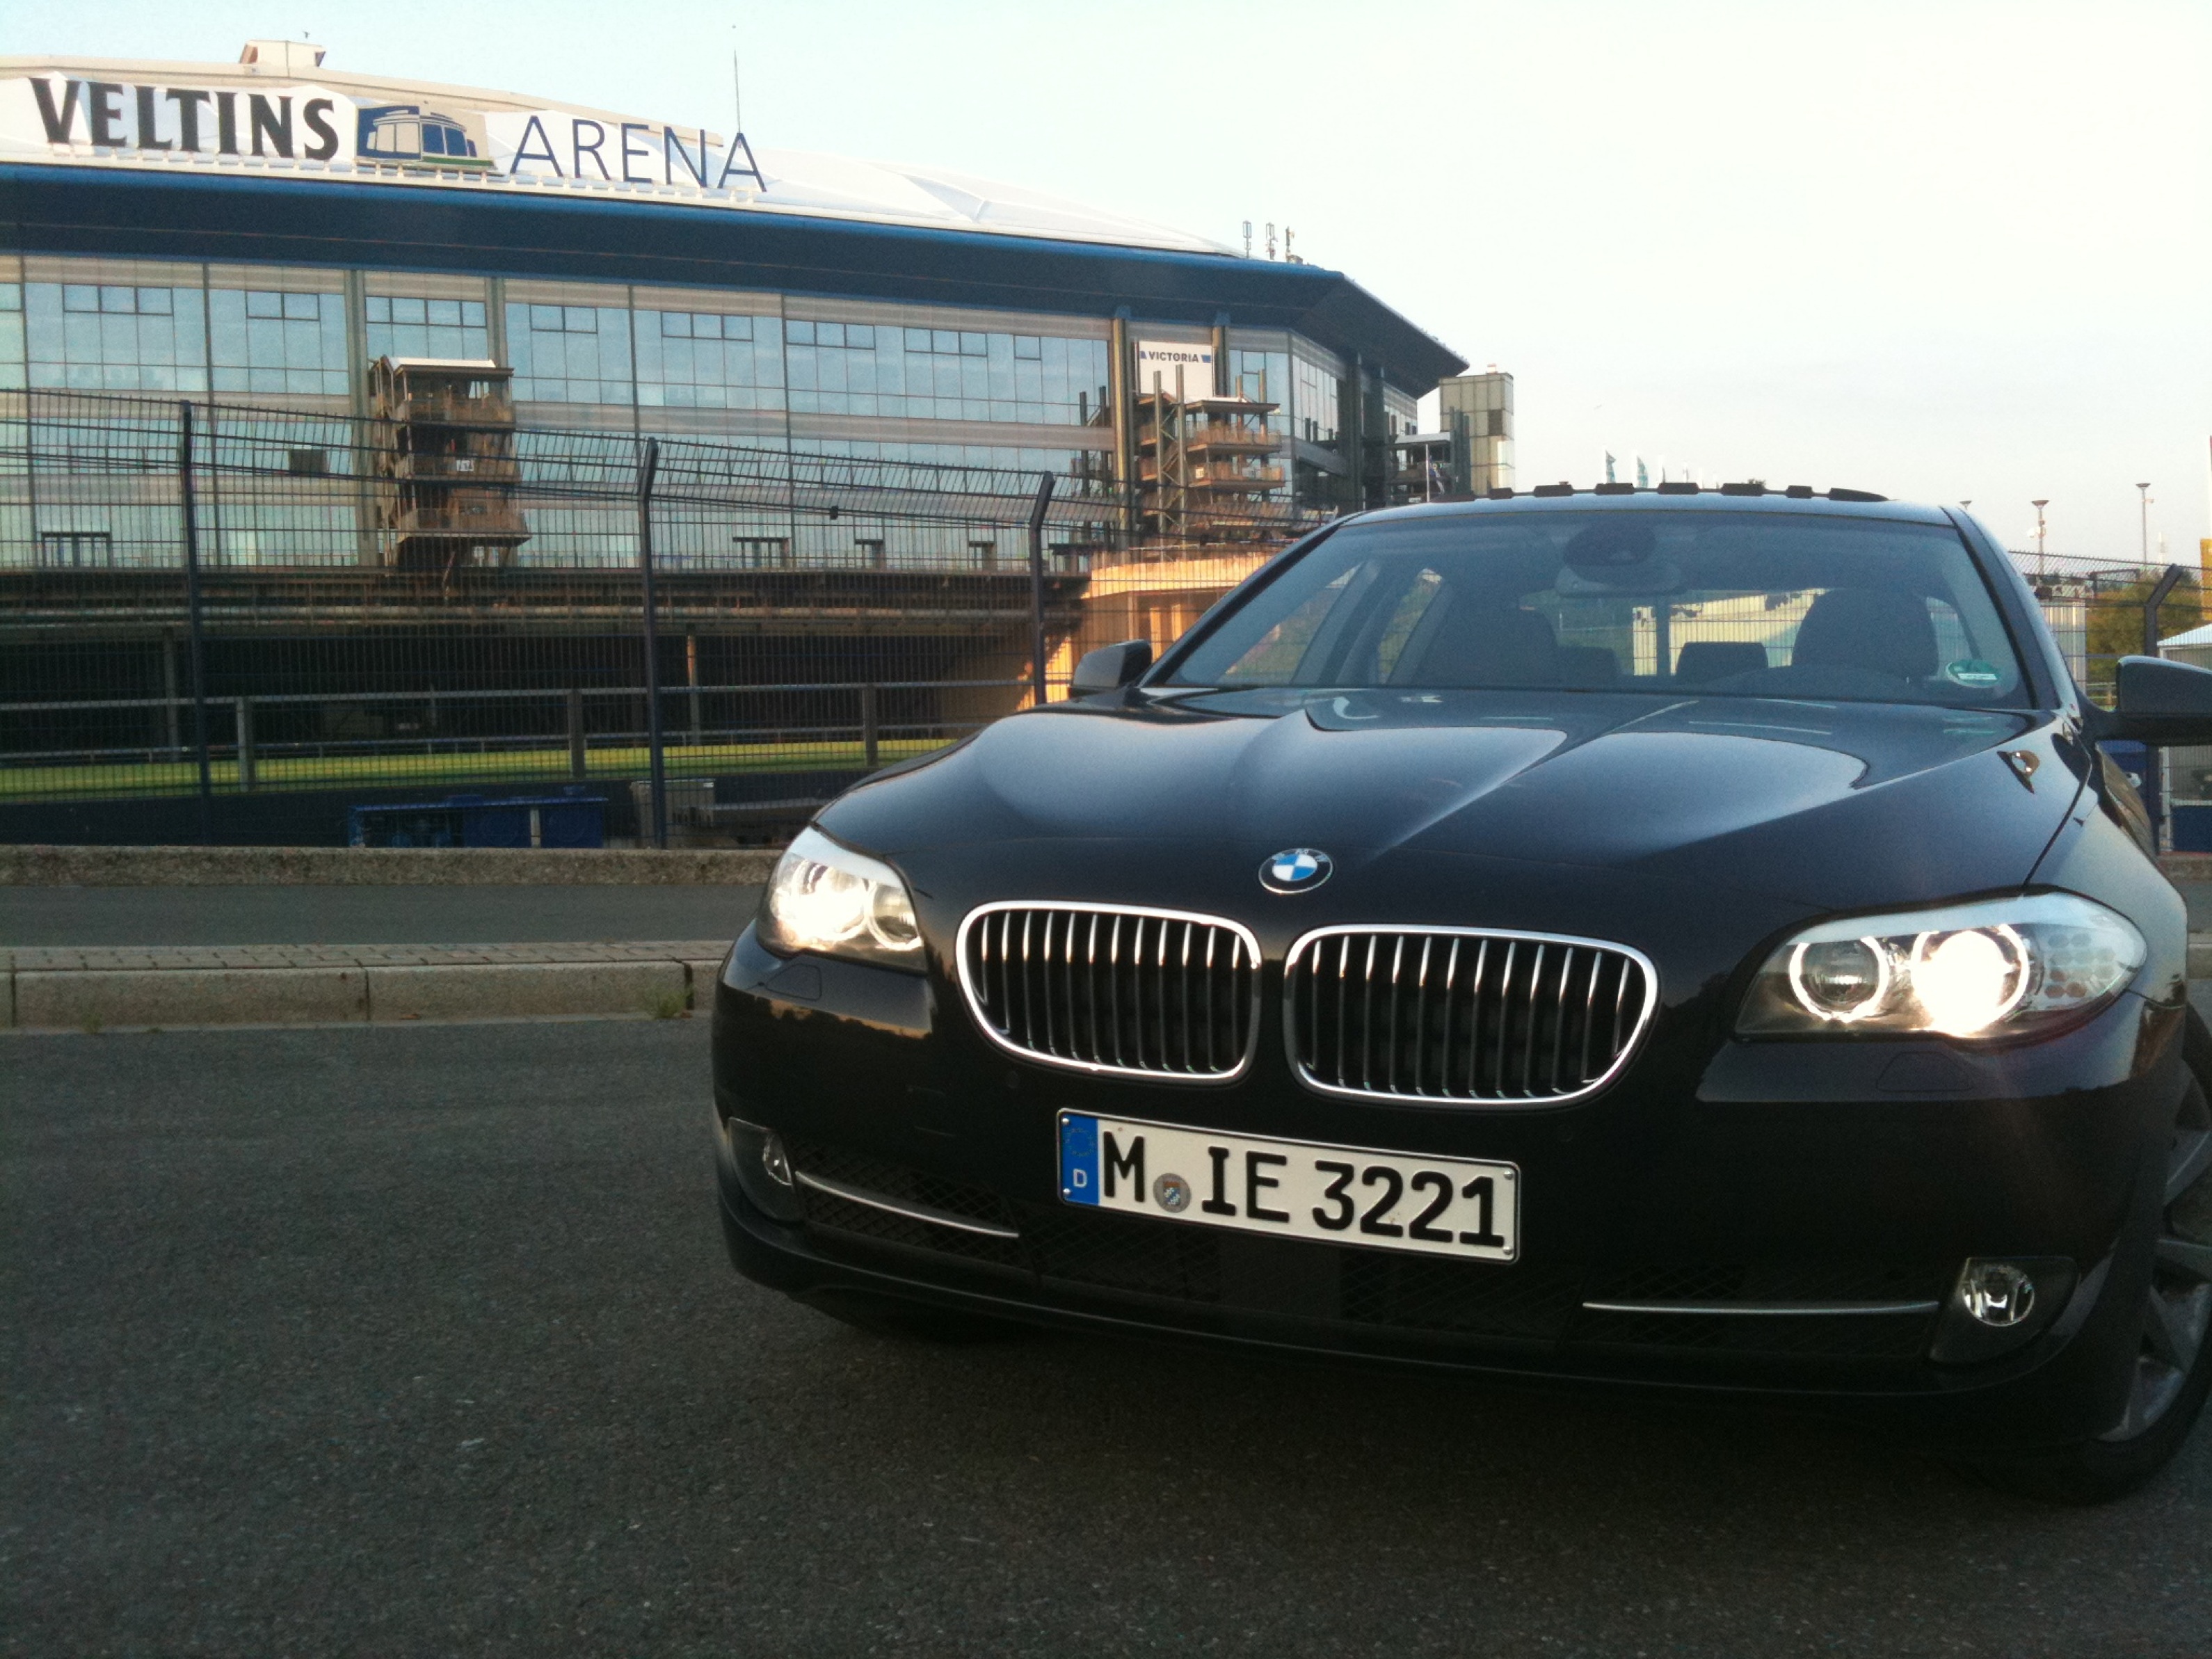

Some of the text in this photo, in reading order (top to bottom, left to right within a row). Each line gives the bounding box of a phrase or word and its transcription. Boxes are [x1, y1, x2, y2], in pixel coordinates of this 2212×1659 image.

[30, 77, 766, 192] VELTINS ARENA
[1148, 351, 1199, 362] VICTORIA
[1073, 1169, 1087, 1187] D
[1103, 1131, 1505, 1248] M IE 3221
